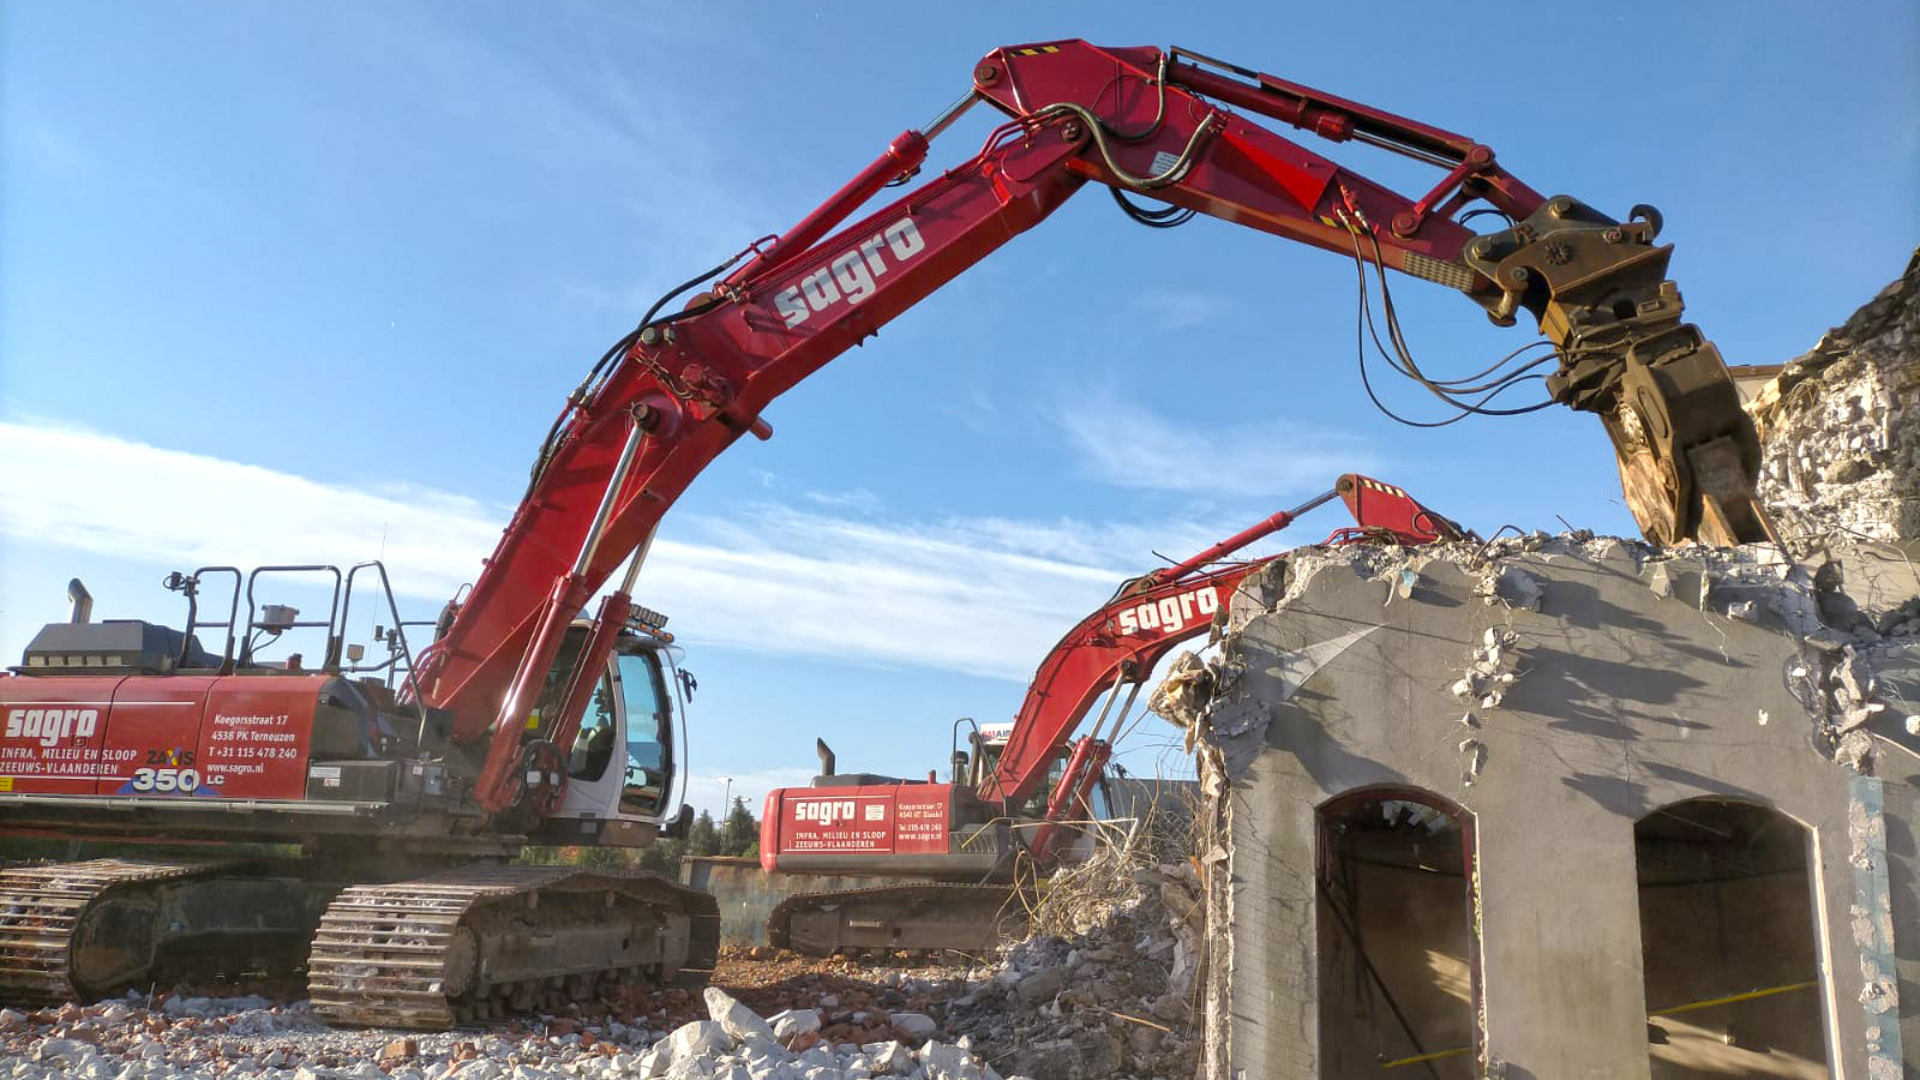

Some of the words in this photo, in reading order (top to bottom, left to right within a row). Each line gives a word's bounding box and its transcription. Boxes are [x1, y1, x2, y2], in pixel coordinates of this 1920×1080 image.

[774, 217, 926, 330] sagro
[1119, 586, 1219, 636] sagro
[276, 715, 289, 726] 17
[4, 709, 98, 747] sagro
[211, 731, 234, 740] 4538
[236, 731, 248, 740] PK
[251, 731, 295, 742] Terneuzen
[1, 748, 37, 761] INFRA,
[42, 748, 80, 760] MILIEU
[84, 749, 98, 760] EN
[102, 749, 138, 761] SLOOP
[209, 746, 215, 757] T
[217, 747, 234, 757] +31
[237, 747, 254, 757] 115
[257, 748, 276, 758] 478
[278, 748, 297, 758] 240
[0, 762, 118, 775] ZEEUWS-VLAANDEREN
[207, 763, 264, 774] www.sagro.nl
[132, 768, 200, 791] 350
[206, 774, 225, 785] LC
[795, 801, 855, 826] sagro
[851, 831, 860, 839] EN
[863, 831, 886, 839] SLOOP
